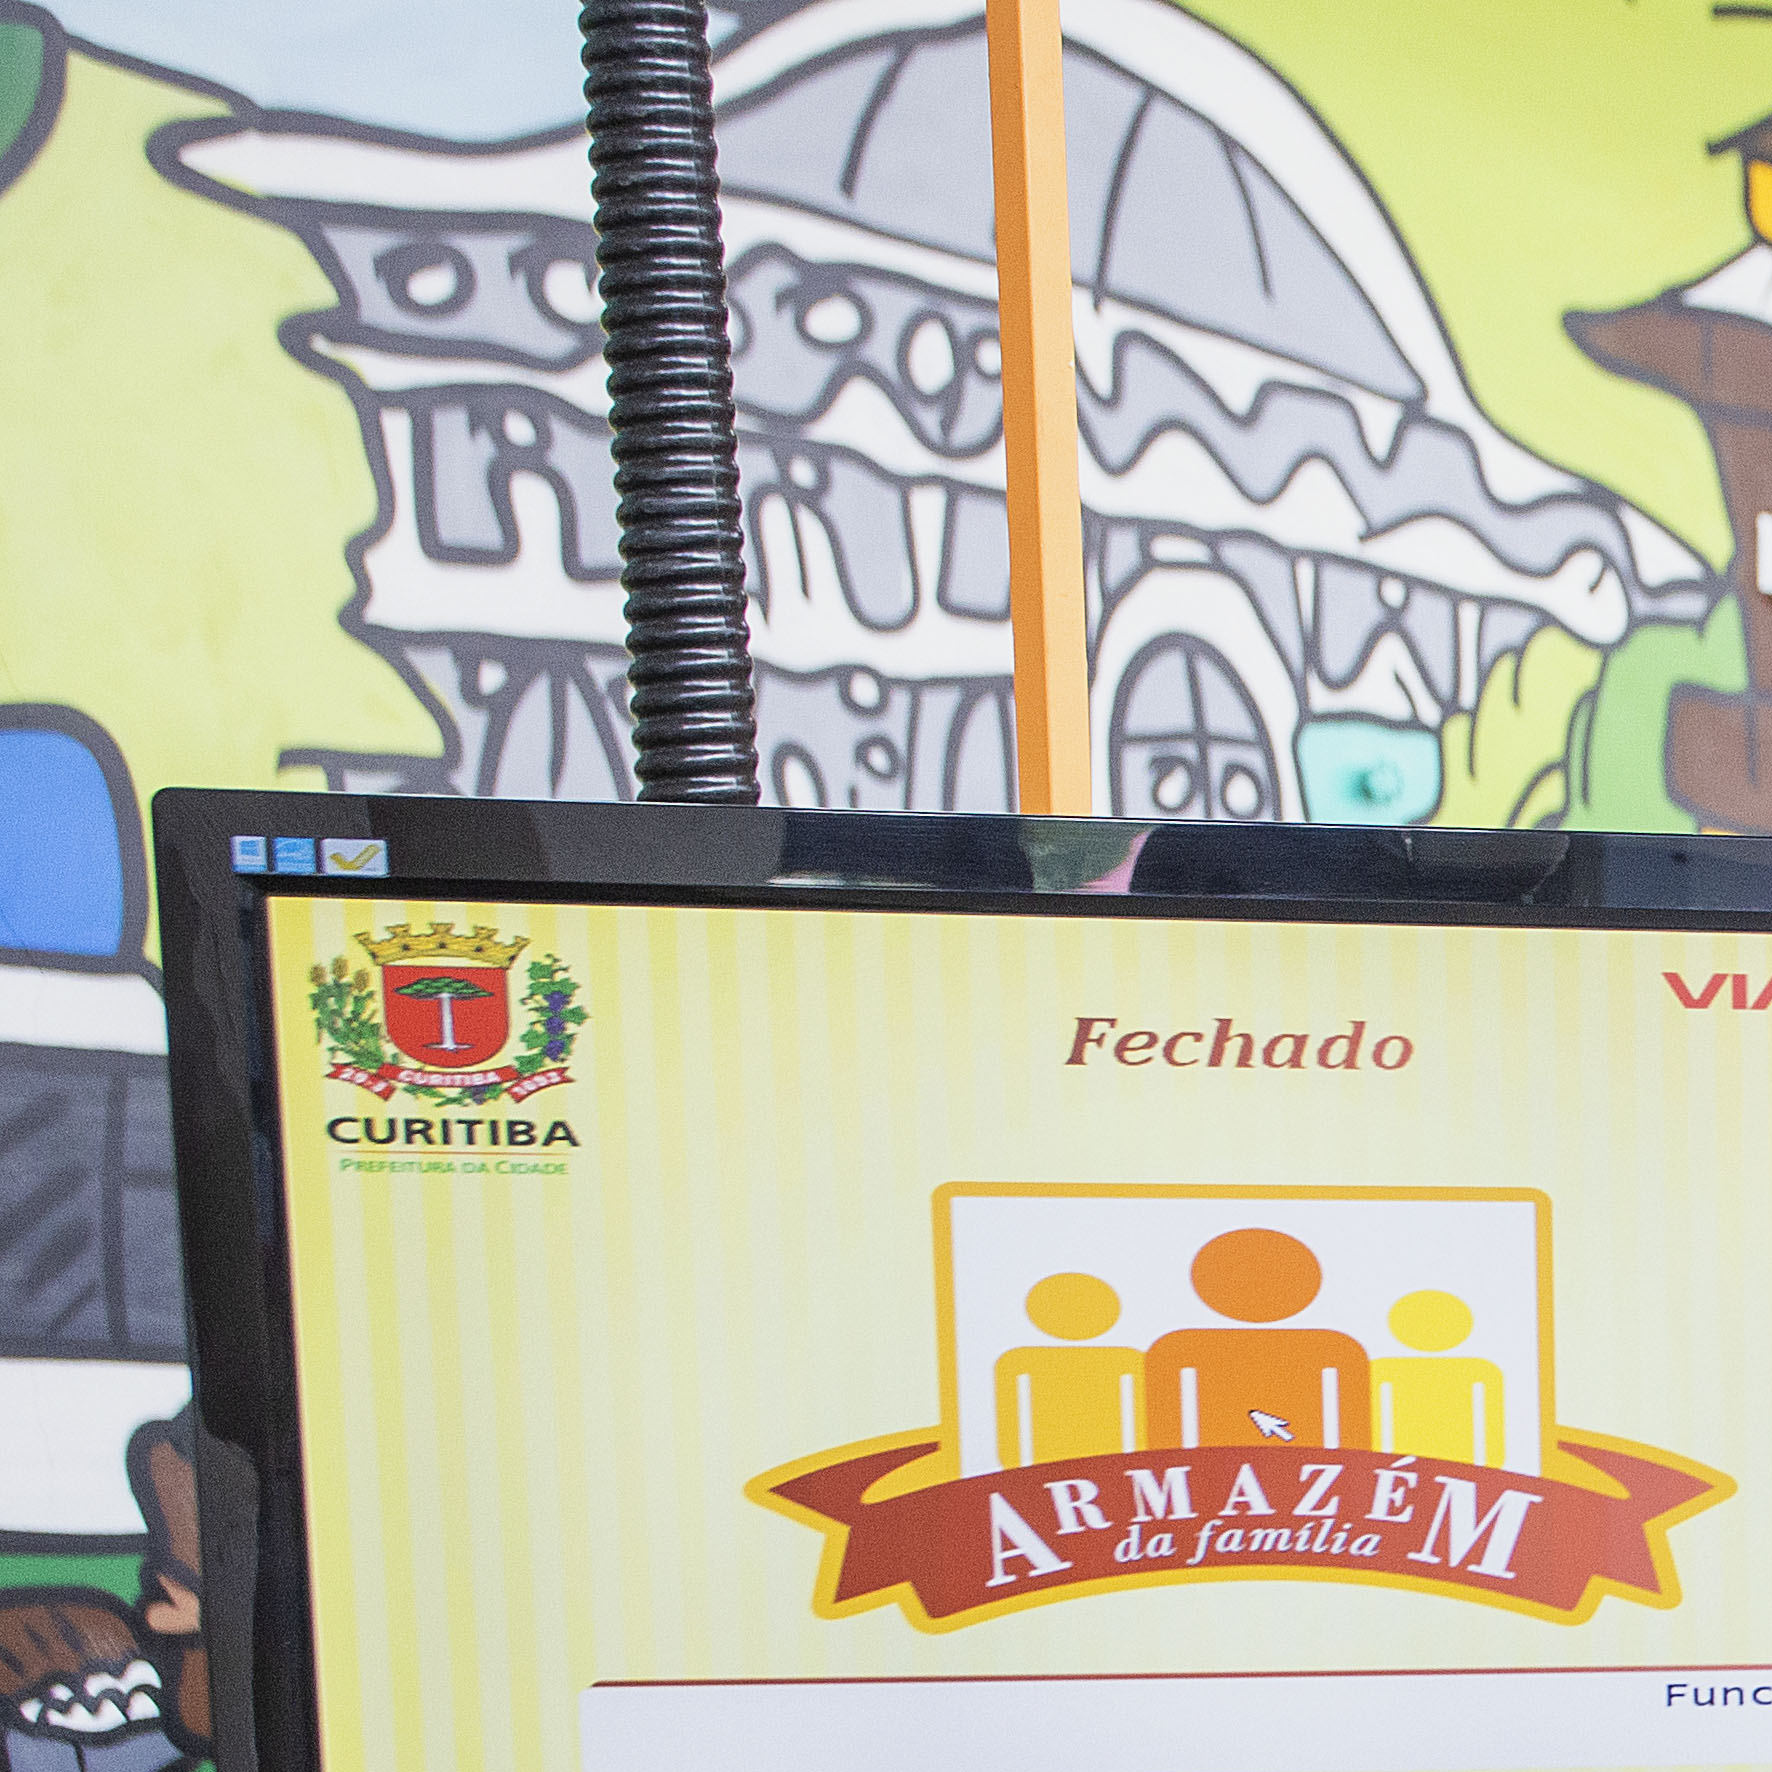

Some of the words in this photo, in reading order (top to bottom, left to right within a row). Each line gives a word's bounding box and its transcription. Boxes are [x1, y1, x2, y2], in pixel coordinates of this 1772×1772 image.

[1065, 1015, 1414, 1071] Fechado
[326, 1116, 581, 1147] CURITIBA
[984, 1455, 1544, 1588] ARMAZÉM
[1113, 1522, 1177, 1563] da
[1186, 1516, 1383, 1566] família
